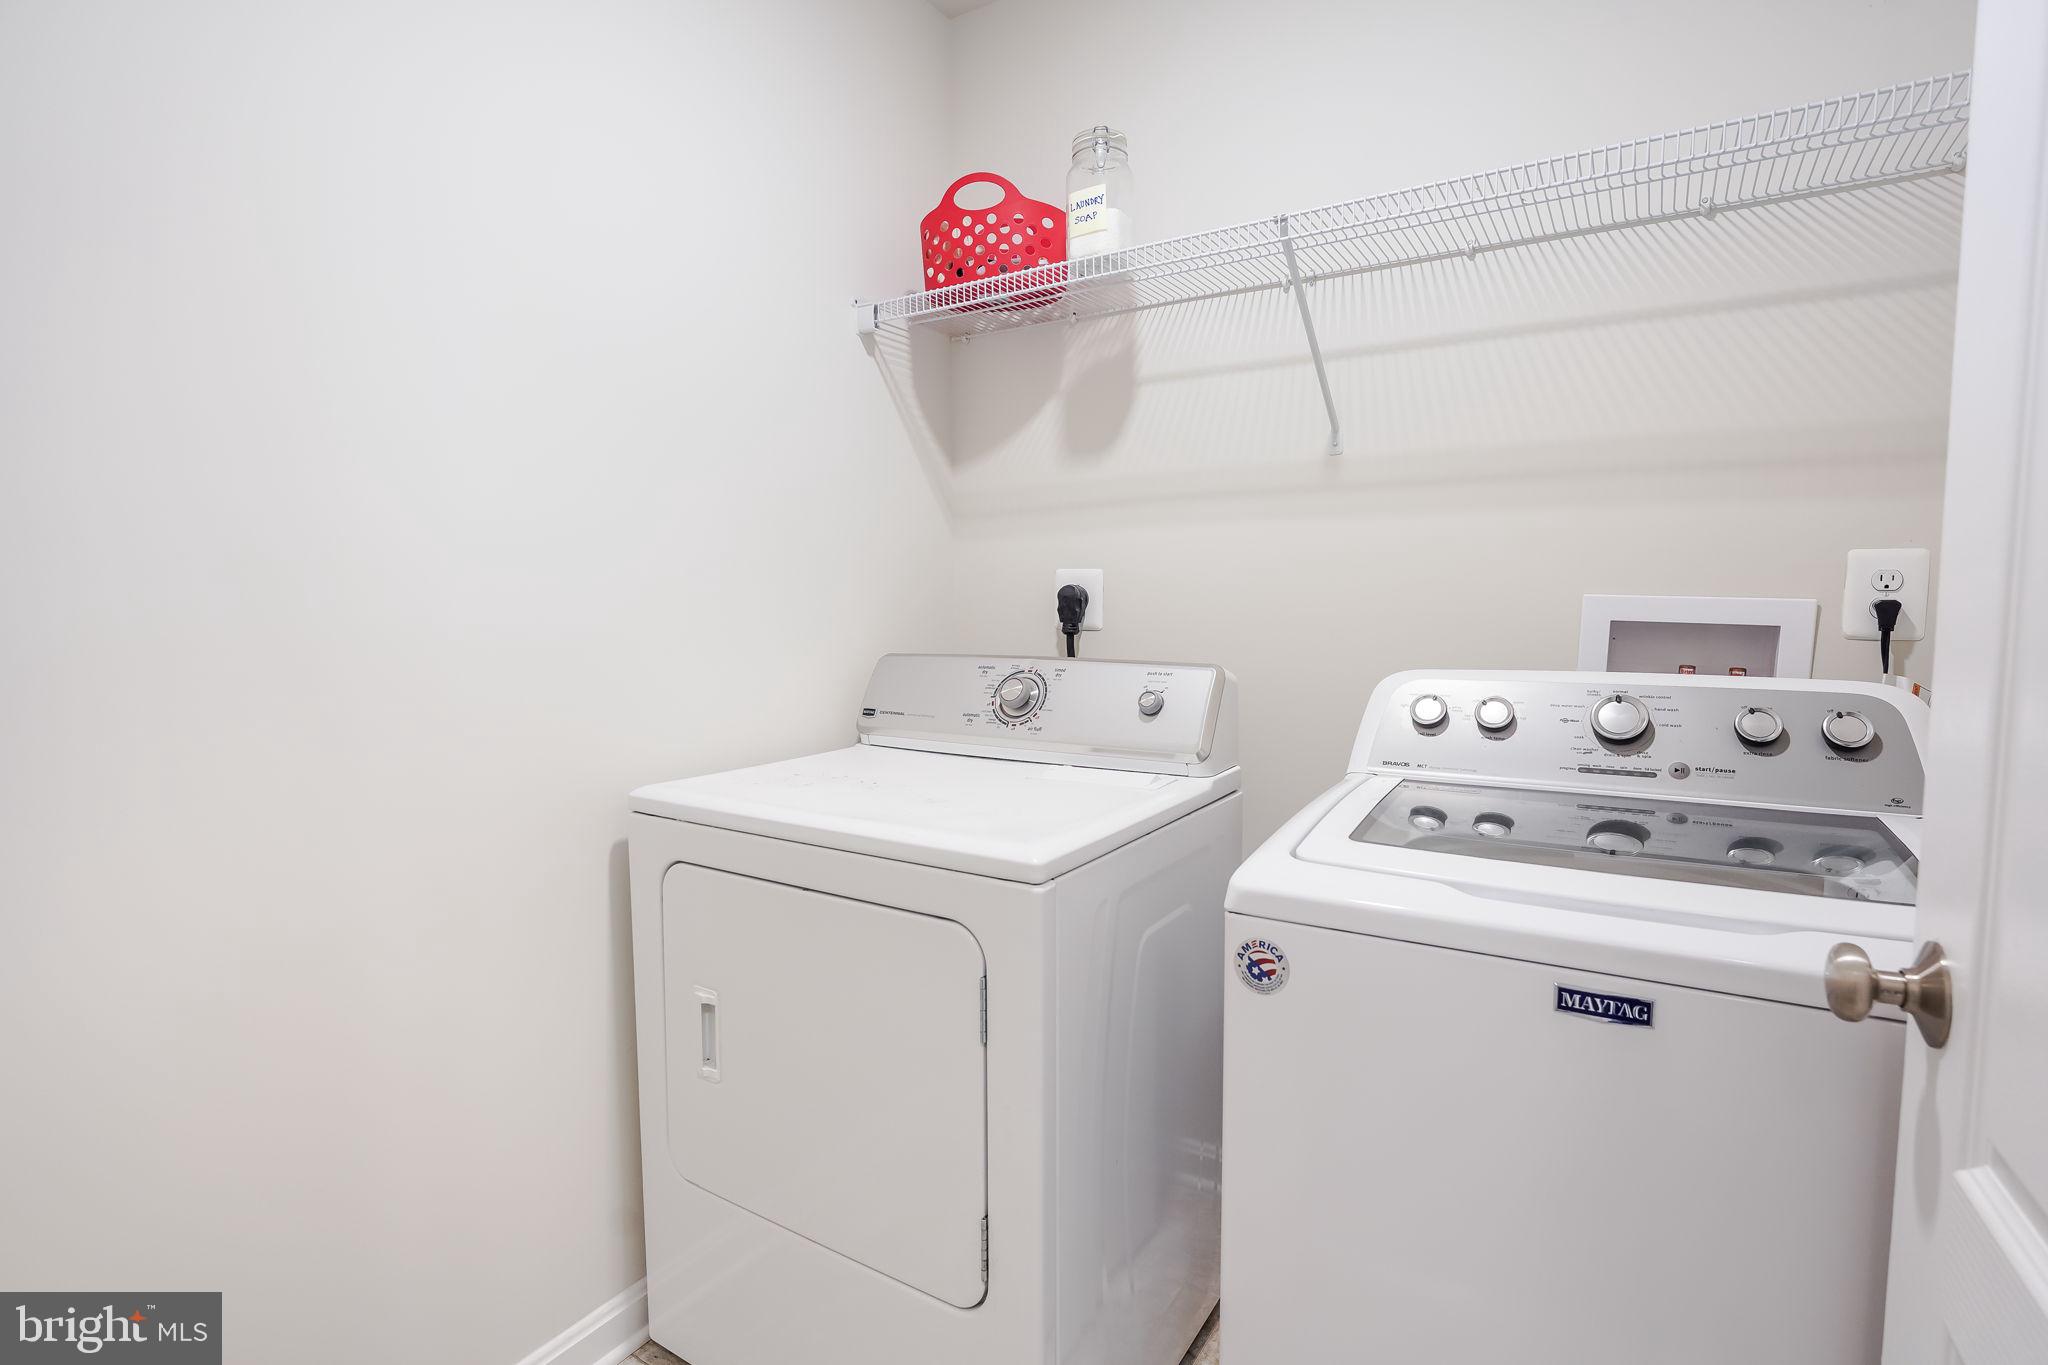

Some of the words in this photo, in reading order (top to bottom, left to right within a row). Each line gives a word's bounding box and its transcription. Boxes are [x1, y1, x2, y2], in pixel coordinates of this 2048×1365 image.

[1070, 194, 1104, 212] LAUNDRY
[1074, 211, 1097, 225] SOAP
[1694, 766, 1736, 774] start/pause
[1237, 940, 1284, 963] AMERICA
[1560, 991, 1649, 1021] MAYTAG
